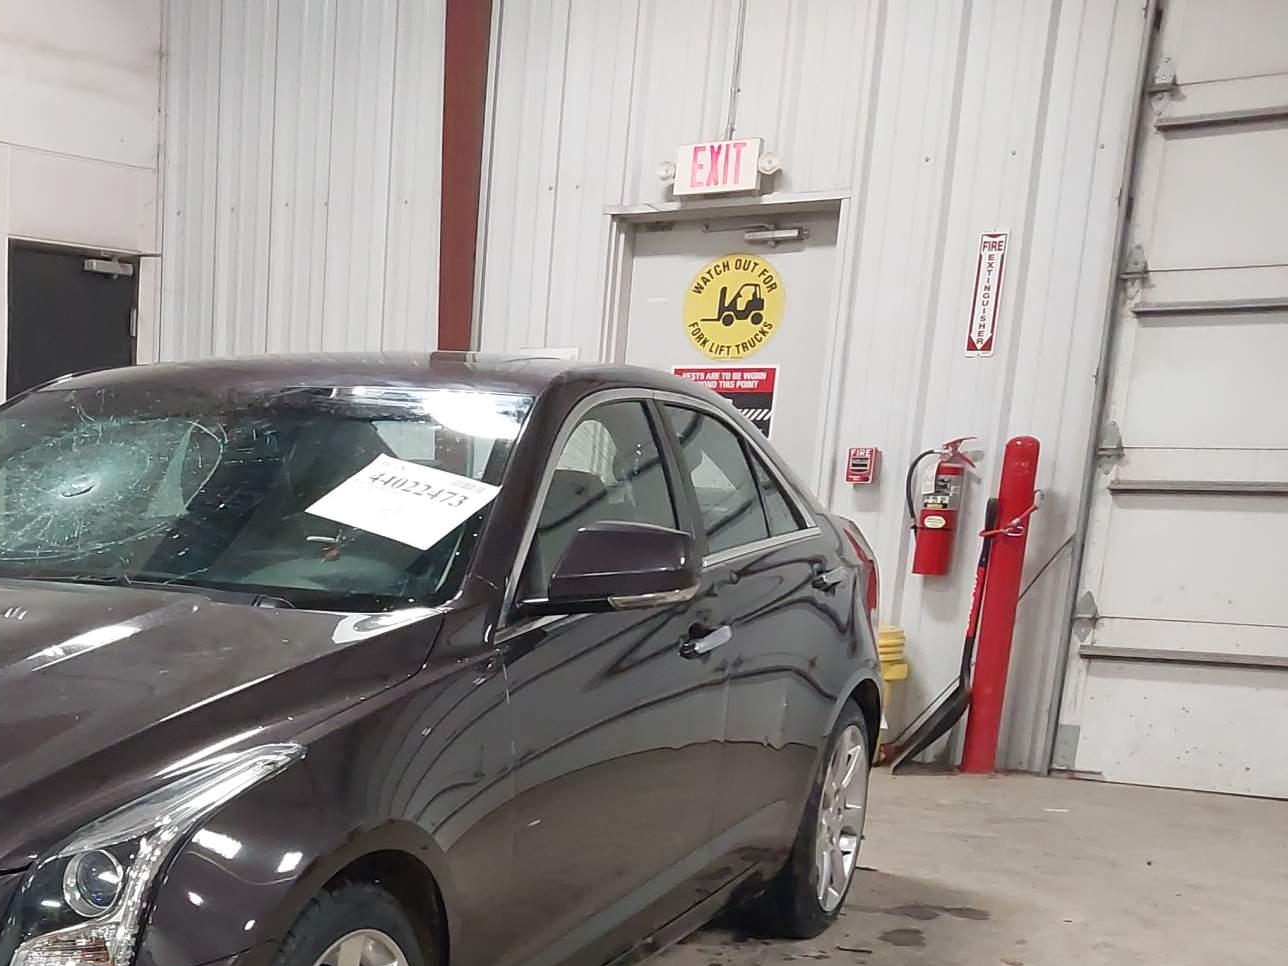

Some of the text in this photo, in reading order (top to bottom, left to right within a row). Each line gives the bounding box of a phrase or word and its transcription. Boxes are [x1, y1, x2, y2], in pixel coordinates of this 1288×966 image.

[690, 142, 746, 188] EXIT
[982, 240, 1004, 252] FIRE
[692, 258, 778, 295] WATCH OUT FOR
[976, 253, 996, 345] EXTINGUISHER
[688, 321, 774, 356] FORK LIFT TRUCKS
[706, 372, 721, 380] ARE
[721, 372, 732, 380] TO
[718, 380, 735, 389] THIS
[735, 380, 760, 389] POINT
[850, 449, 873, 457] FIRE
[368, 472, 469, 507] 44022473
